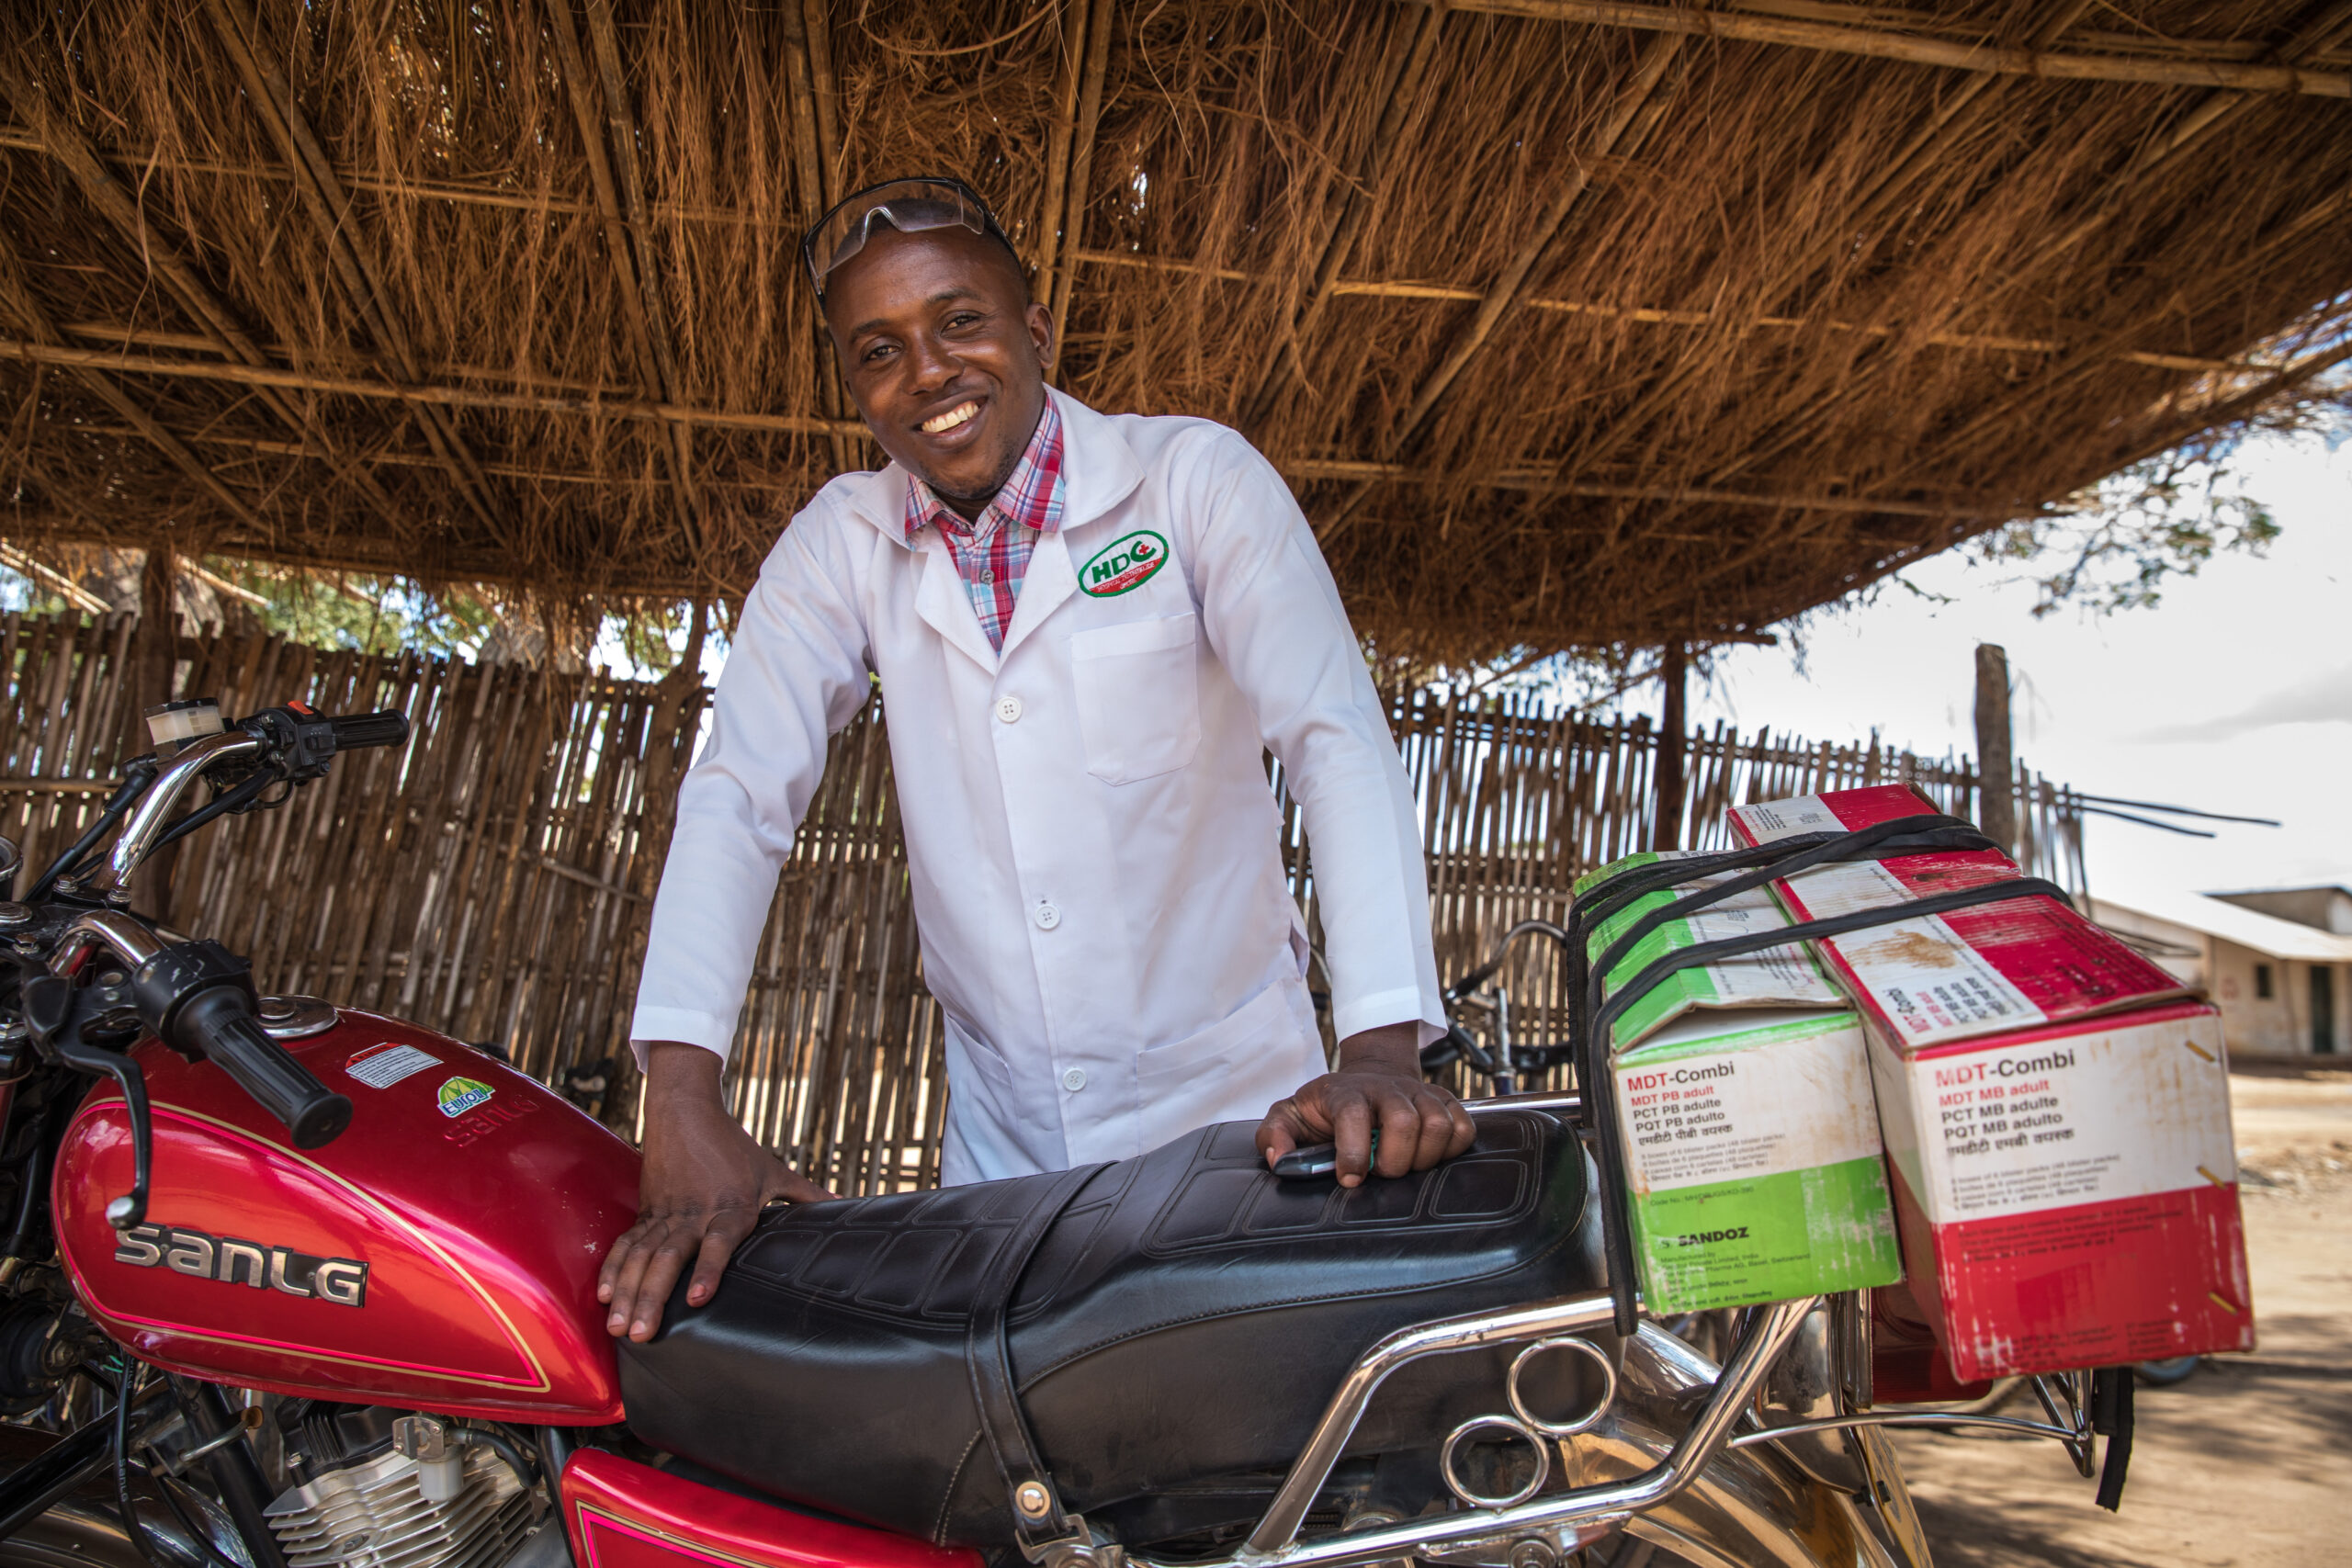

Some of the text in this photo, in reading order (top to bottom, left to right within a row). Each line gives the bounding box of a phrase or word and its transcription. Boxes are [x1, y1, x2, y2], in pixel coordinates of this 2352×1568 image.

[1091, 540, 1157, 584] HDC
[1627, 1061, 1735, 1091] MDT-Combi
[1935, 1048, 2075, 1089] MDT-Combi
[1631, 1086, 1714, 1107] MDT PB adult
[1939, 1079, 2050, 1107] MDT MB adult
[1634, 1099, 1722, 1120] PCT PB adulte
[1635, 1111, 1725, 1133] PQT PB adulto
[1941, 1097, 2059, 1123] PCT MB adulte
[1943, 1113, 2063, 1141] PQT MB adulto
[1678, 1226, 1750, 1247] SANDOZ
